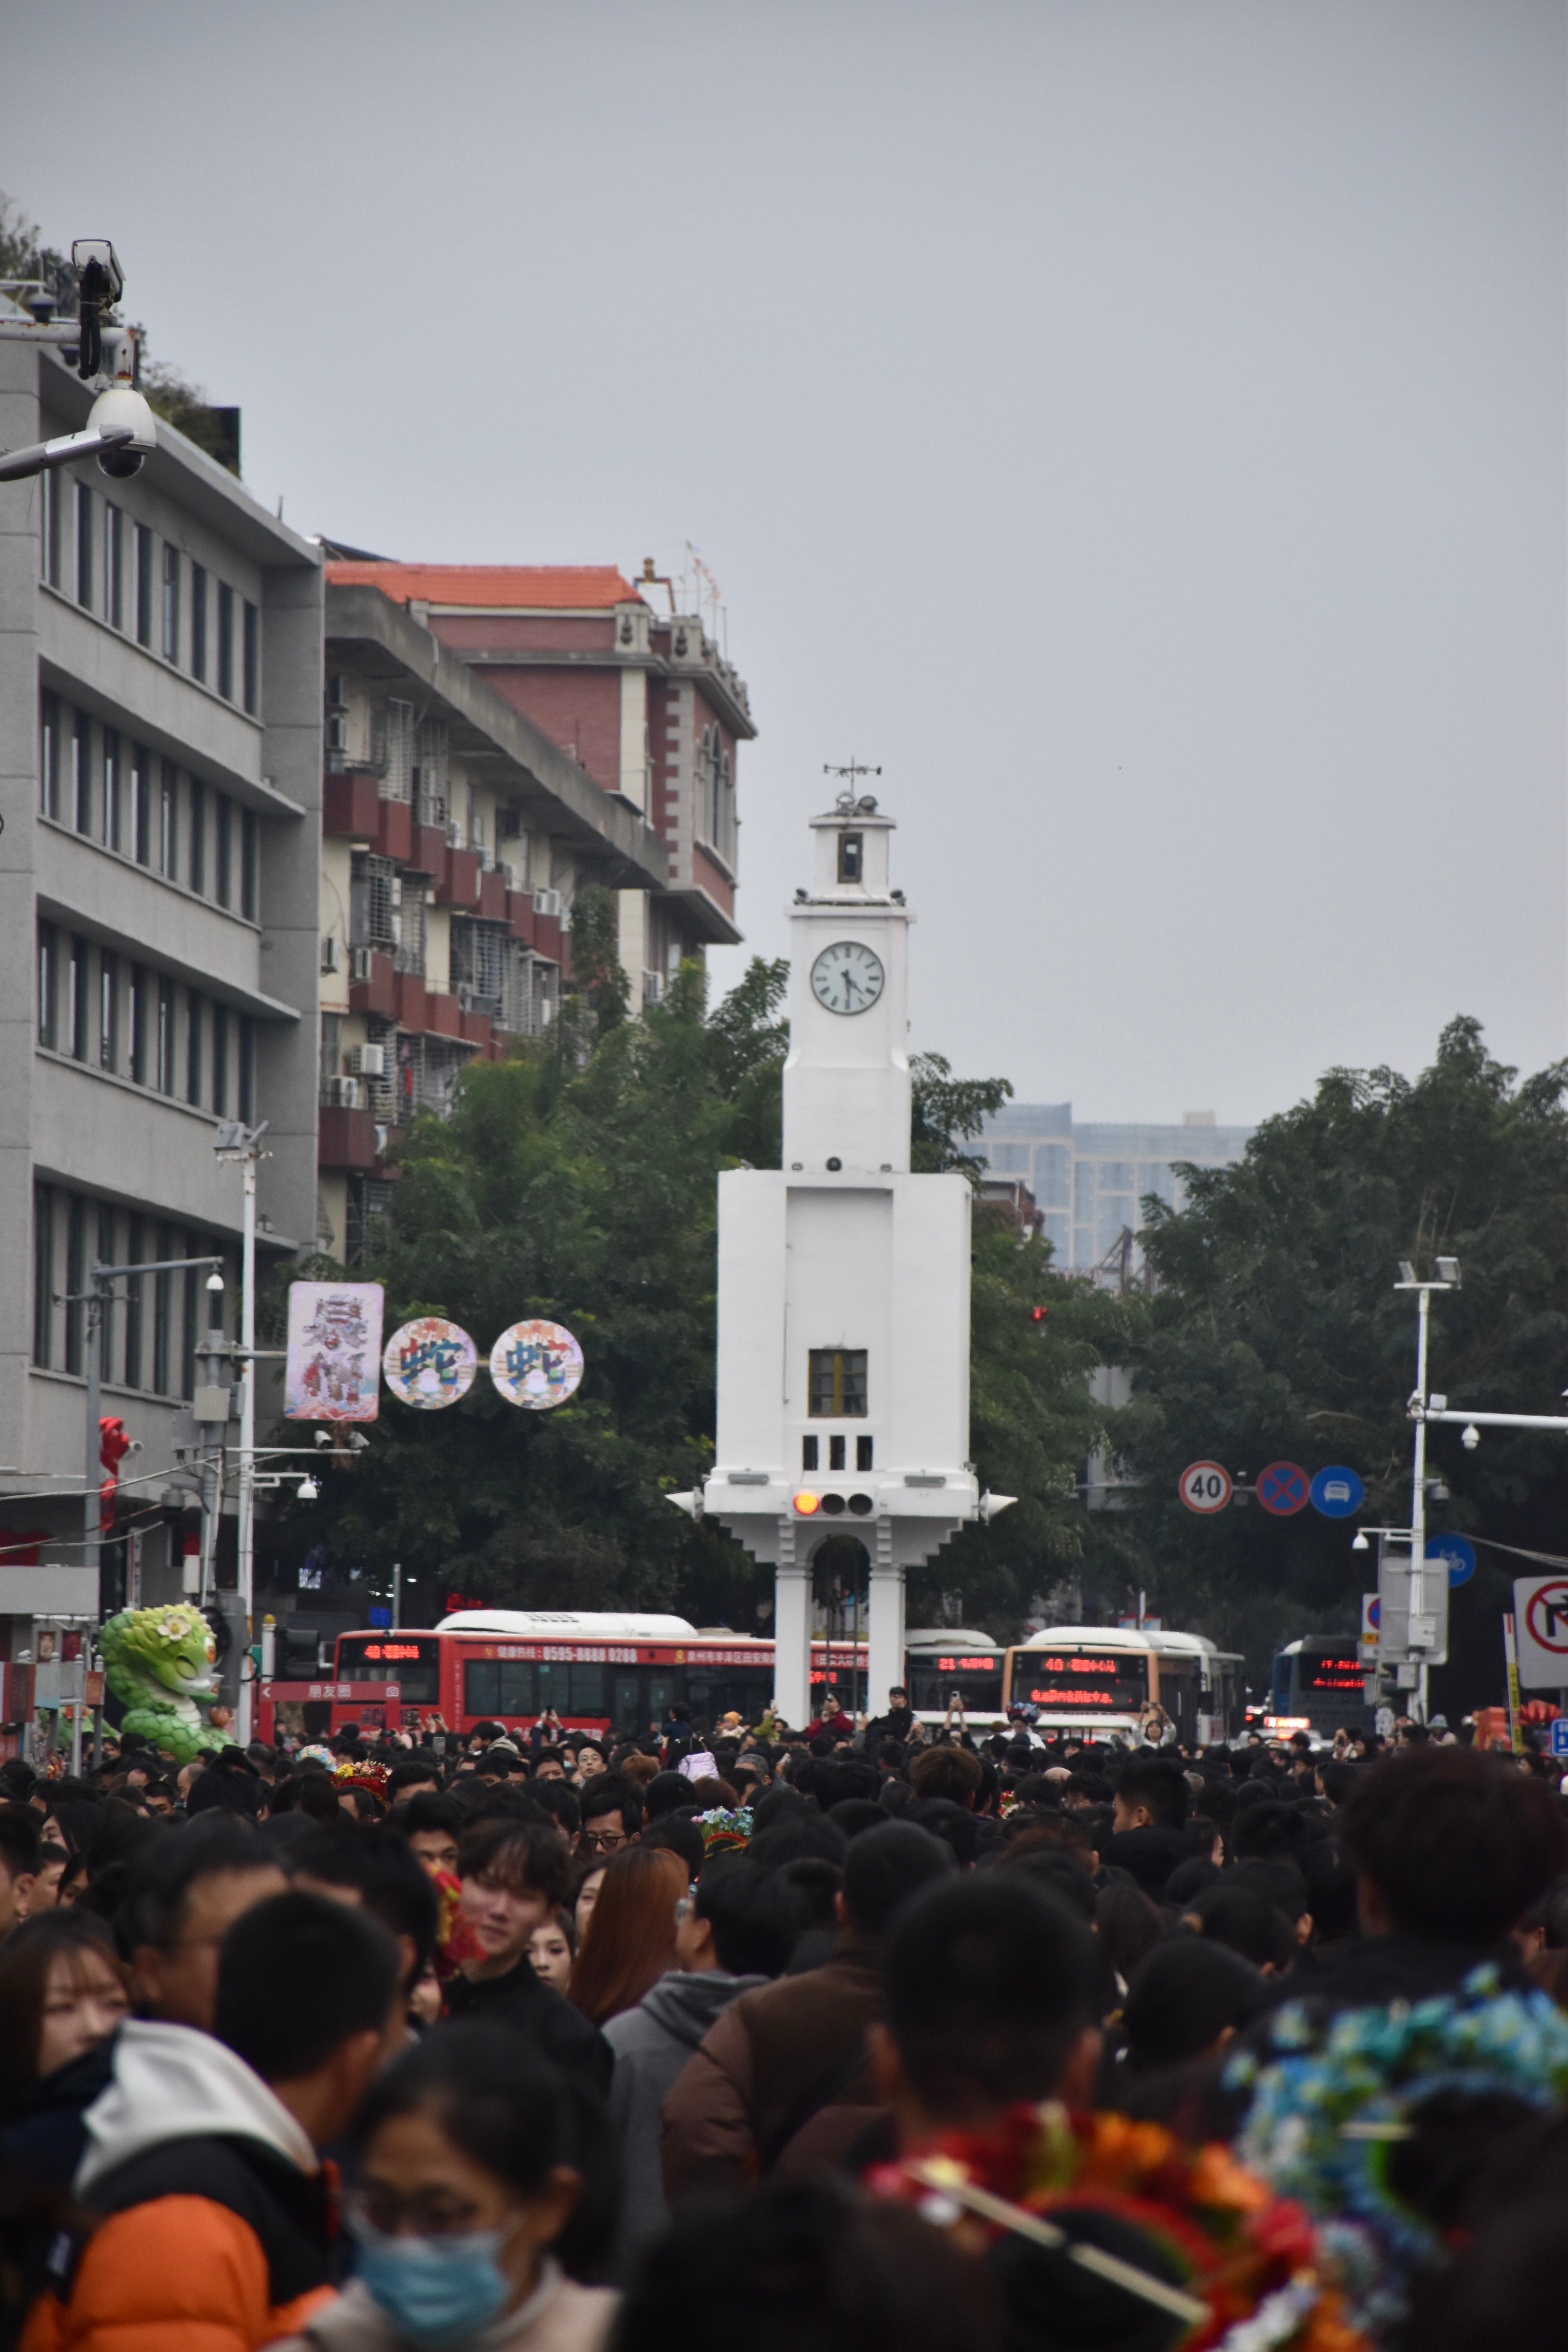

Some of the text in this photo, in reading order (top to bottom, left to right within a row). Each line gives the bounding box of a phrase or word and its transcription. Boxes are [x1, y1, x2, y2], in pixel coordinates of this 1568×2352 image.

[1191, 1474, 1221, 1498] 40
[939, 1657, 955, 1671] 21
[1045, 1657, 1064, 1672] 40
[309, 1684, 352, 1698] 朋友圈
